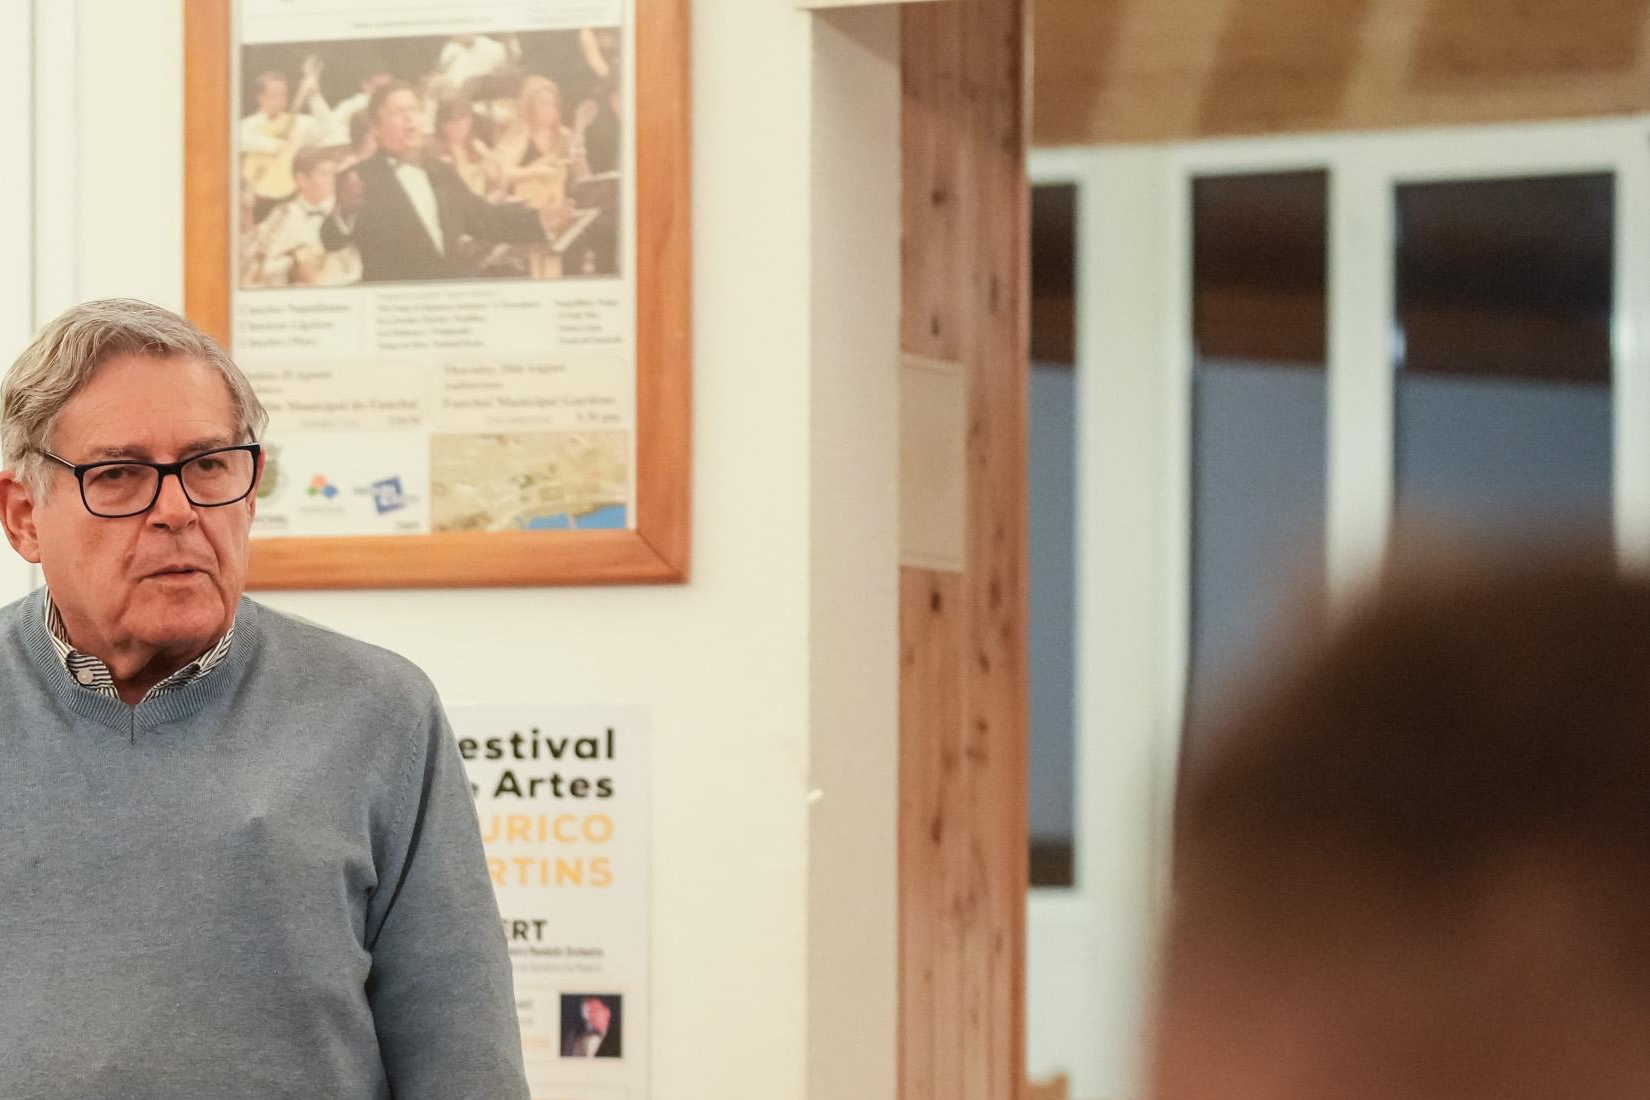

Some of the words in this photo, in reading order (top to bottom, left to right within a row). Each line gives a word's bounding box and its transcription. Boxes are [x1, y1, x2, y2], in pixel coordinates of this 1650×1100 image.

[457, 728, 615, 760] estival
[494, 770, 614, 799] Artes
[482, 813, 616, 844] URICO
[488, 856, 614, 888] RTINS
